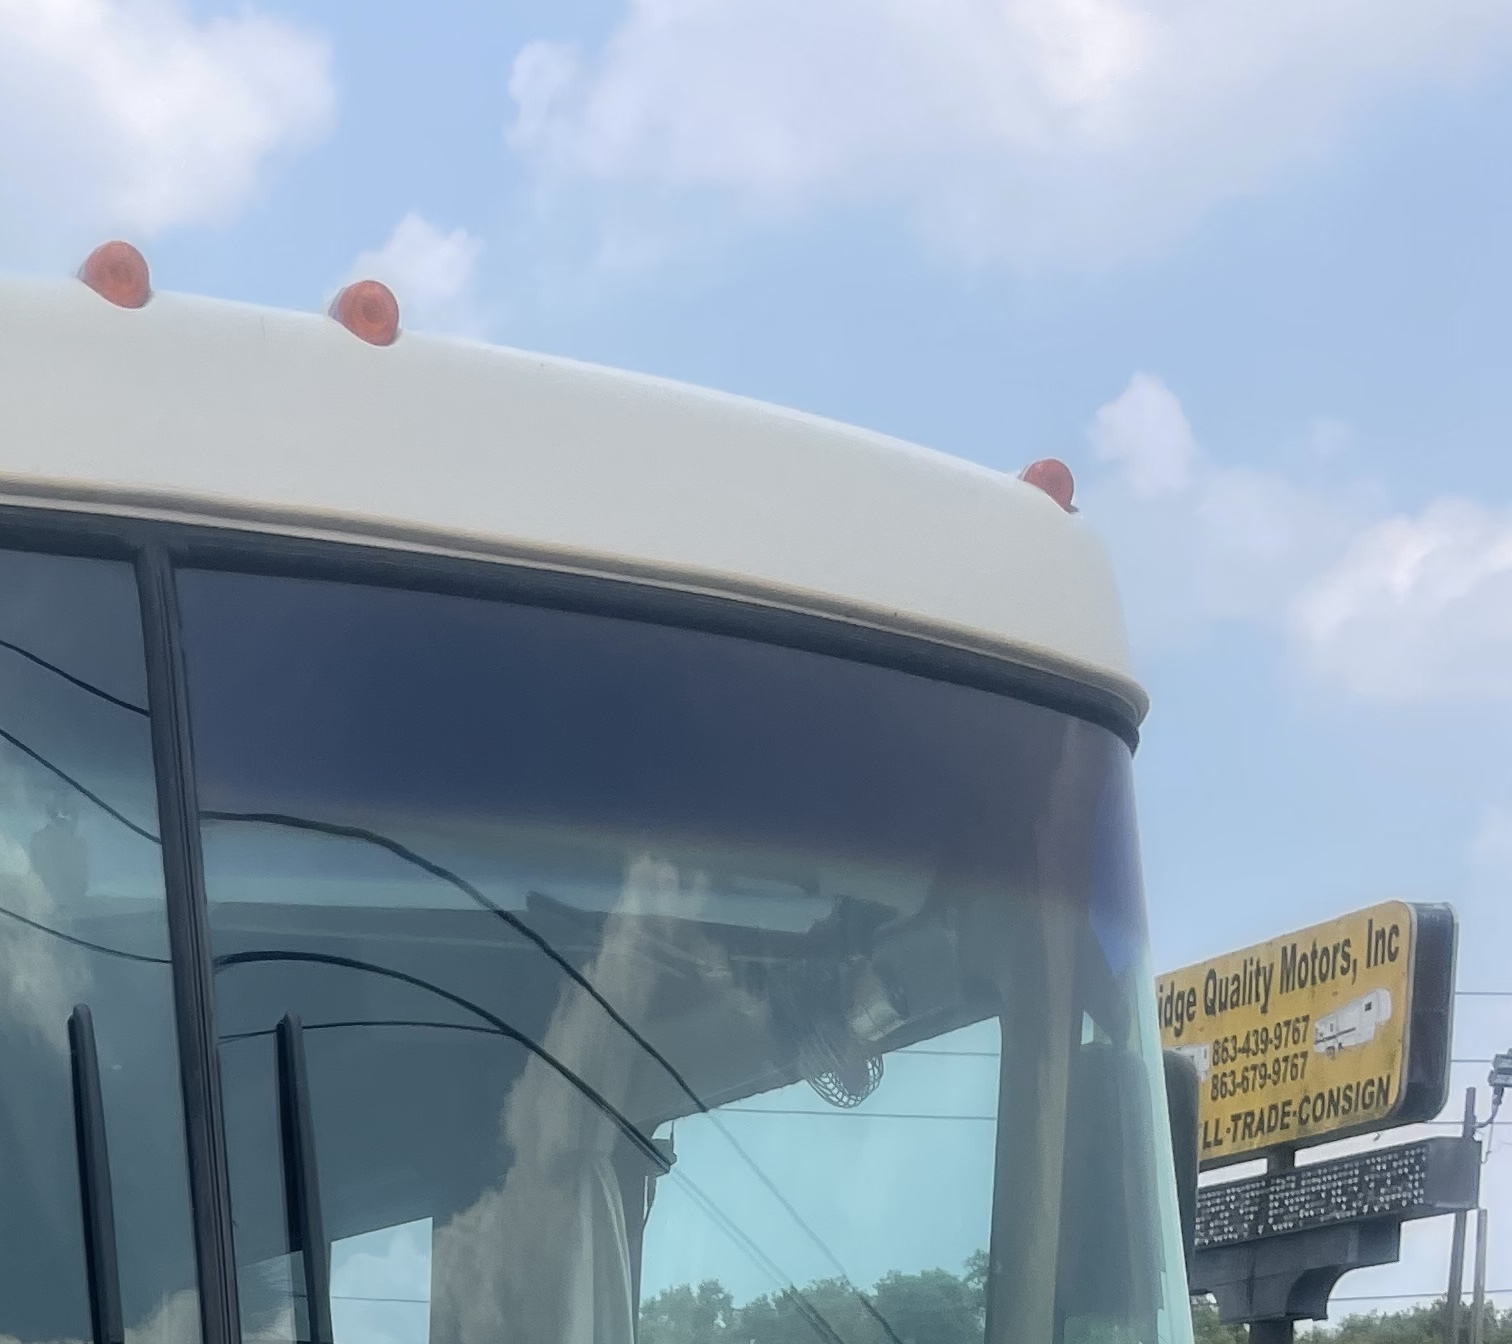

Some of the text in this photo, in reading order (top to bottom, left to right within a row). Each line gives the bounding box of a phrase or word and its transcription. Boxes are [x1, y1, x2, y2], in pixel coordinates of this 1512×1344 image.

[1158, 917, 1400, 1037] idge Quality Motors, Inc
[1212, 1014, 1310, 1067] 863-439-9767
[1210, 1050, 1309, 1101] 863-679-9767
